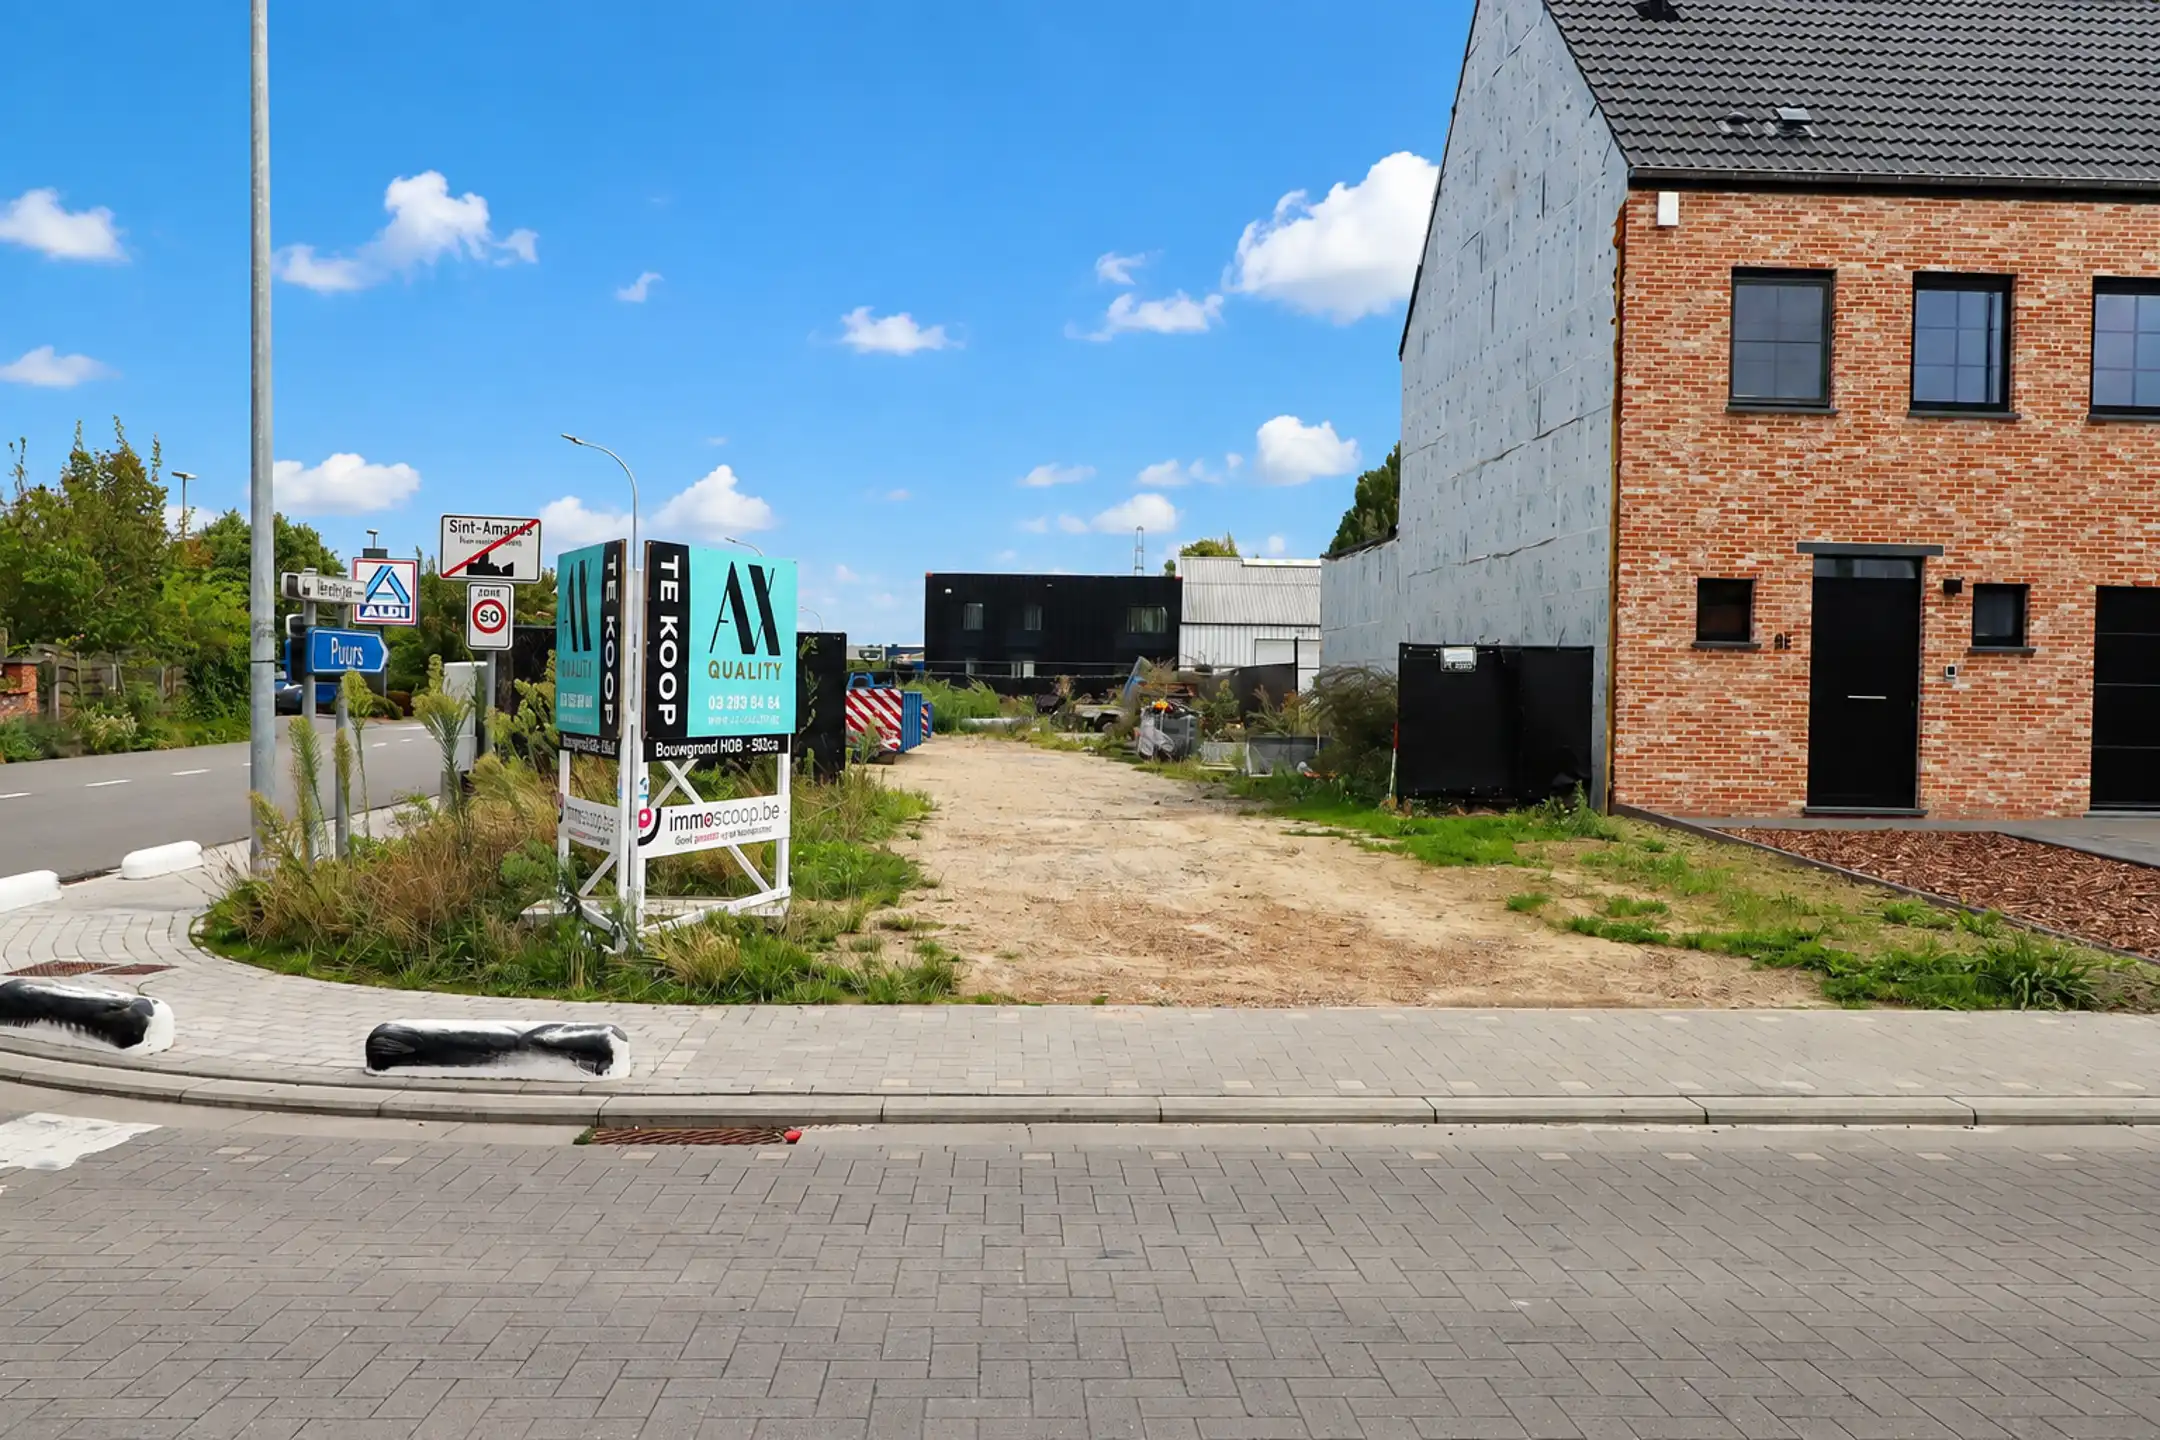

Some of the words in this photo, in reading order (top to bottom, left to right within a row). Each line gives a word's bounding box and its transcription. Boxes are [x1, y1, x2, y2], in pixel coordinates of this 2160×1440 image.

[449, 519, 533, 537] Sint-Amands
[606, 555, 617, 602] TE
[660, 555, 679, 602] TE
[362, 605, 406, 618] ALDI
[709, 561, 781, 656] AX
[331, 637, 364, 665] Puurs
[604, 616, 616, 725] KOOP
[658, 615, 678, 725] KOOP
[708, 660, 782, 680] QUALITY
[708, 695, 724, 710] 03
[656, 737, 718, 758] Bouwgrond
[669, 801, 780, 832] immoscoop.be
